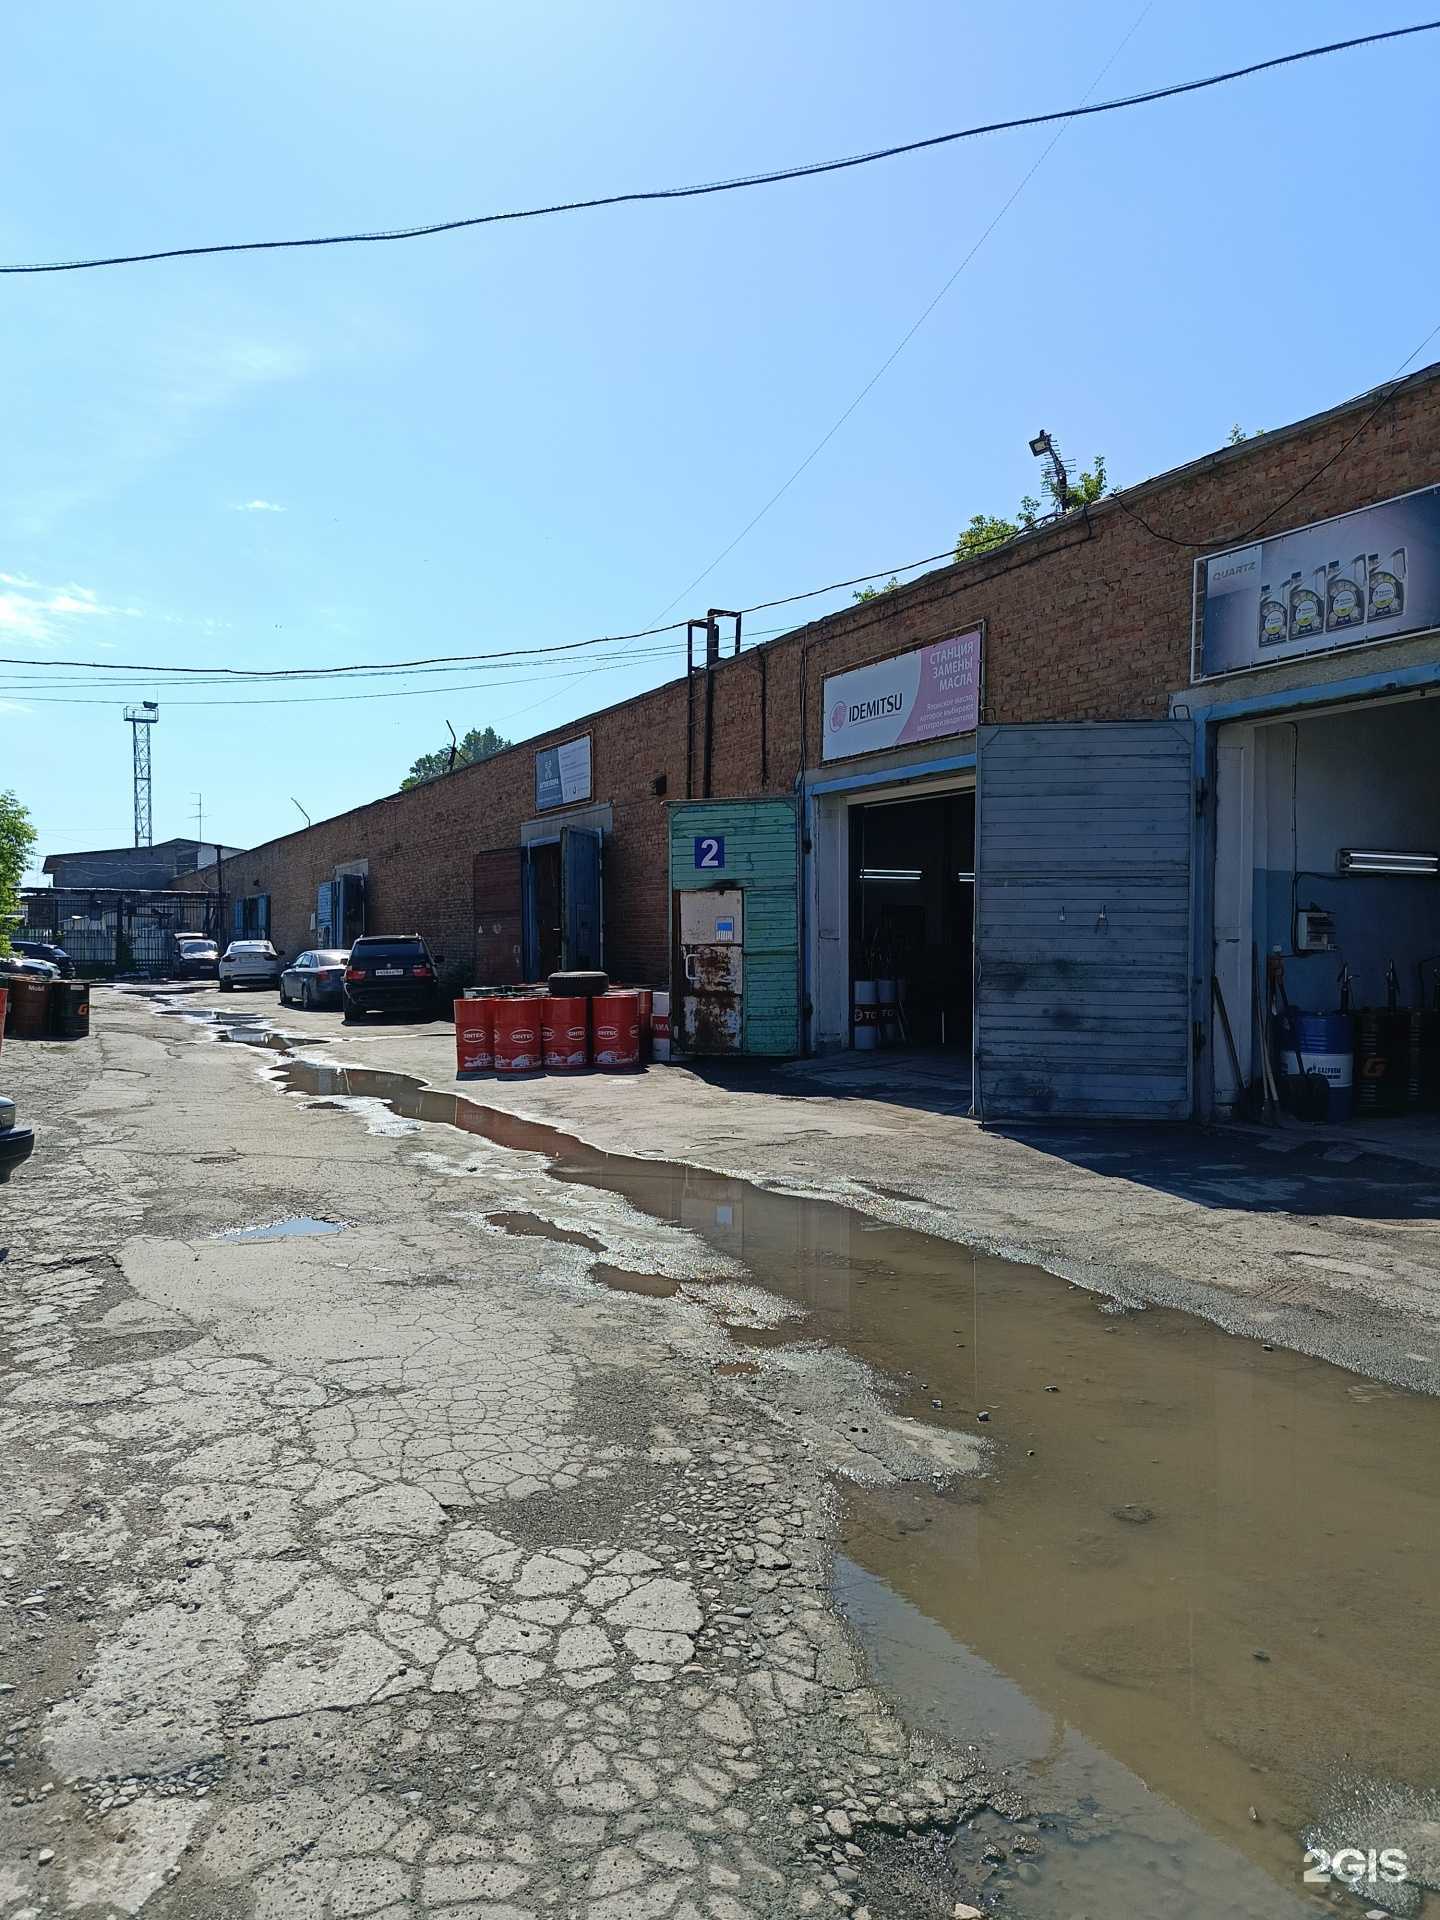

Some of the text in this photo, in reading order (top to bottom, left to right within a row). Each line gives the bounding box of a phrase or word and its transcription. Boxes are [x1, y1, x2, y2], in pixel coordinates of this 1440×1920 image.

[1213, 560, 1256, 581] QUARTZ
[929, 640, 974, 665] СТАНЦИЯ
[933, 655, 973, 679] ЗАМЕНЫ
[939, 673, 973, 692] МАСЛА
[848, 692, 903, 723] IDEMITSU
[701, 839, 719, 866] 2
